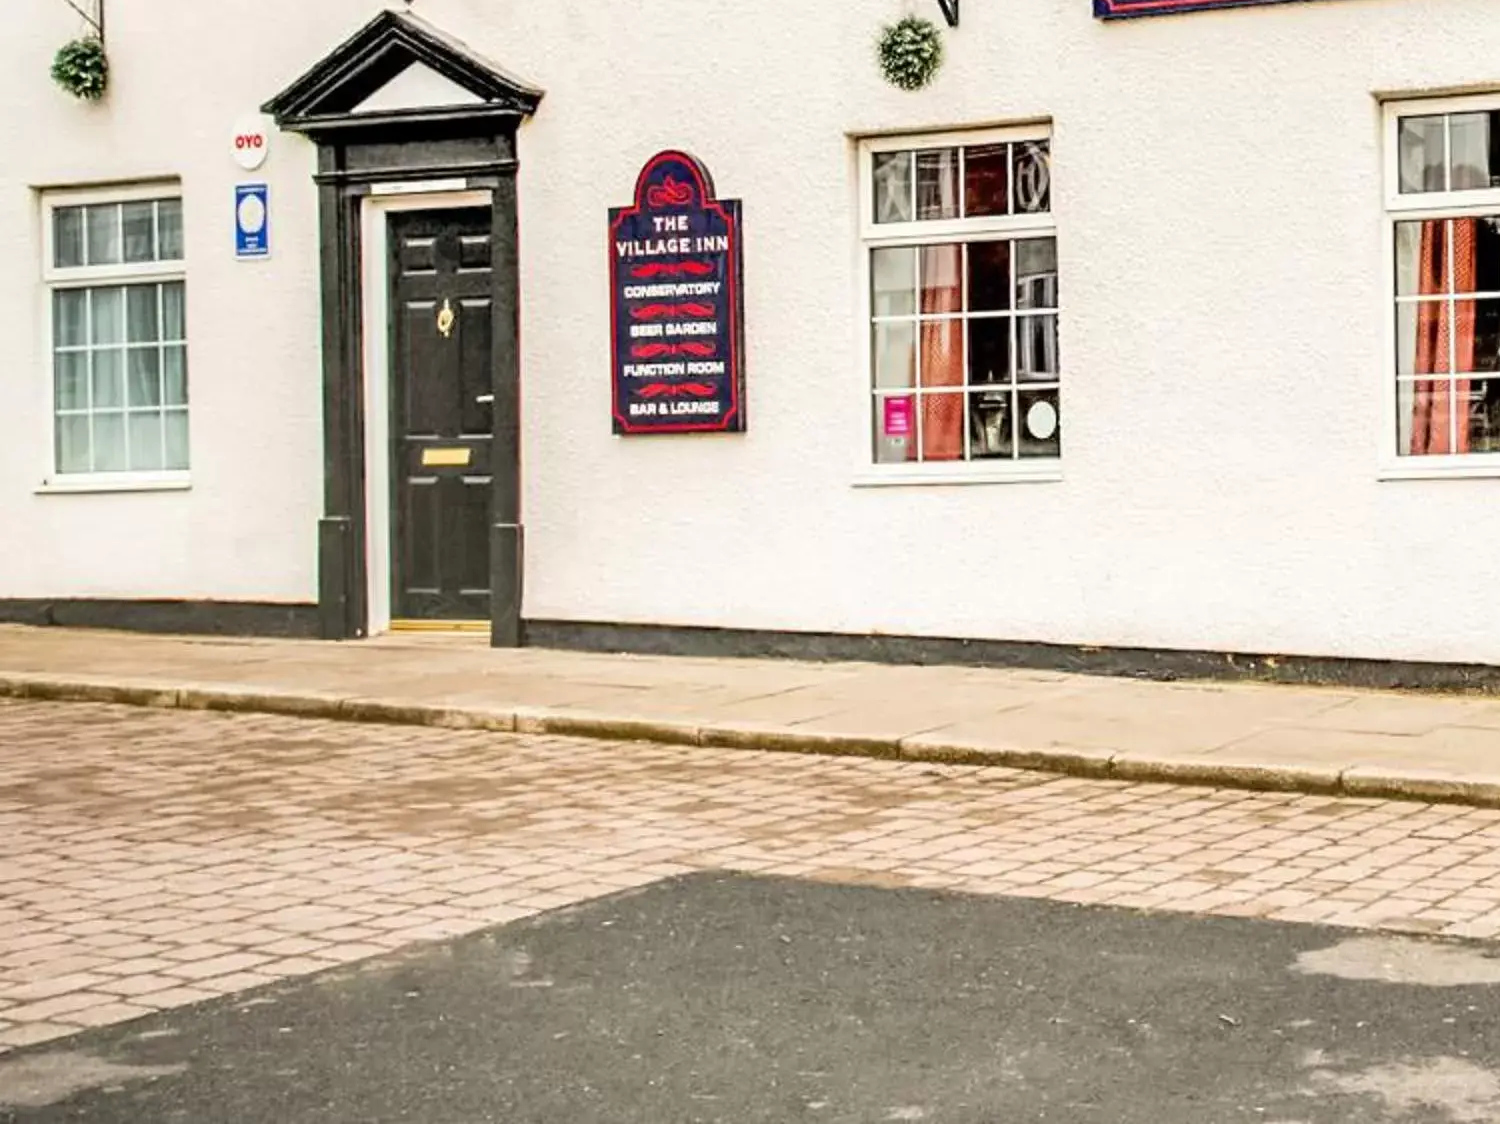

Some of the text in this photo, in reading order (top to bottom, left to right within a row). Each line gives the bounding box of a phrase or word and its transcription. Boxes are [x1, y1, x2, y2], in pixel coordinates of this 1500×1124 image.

[235, 135, 263, 149] OYO
[653, 215, 689, 232] THE
[616, 235, 729, 257] VILLAGE INN
[623, 281, 721, 299] CONSERVATORY
[630, 321, 717, 338] BEER GARDEN
[623, 361, 725, 377] FUNCTION ROOM
[629, 401, 720, 415] BAR & LOUNGE
